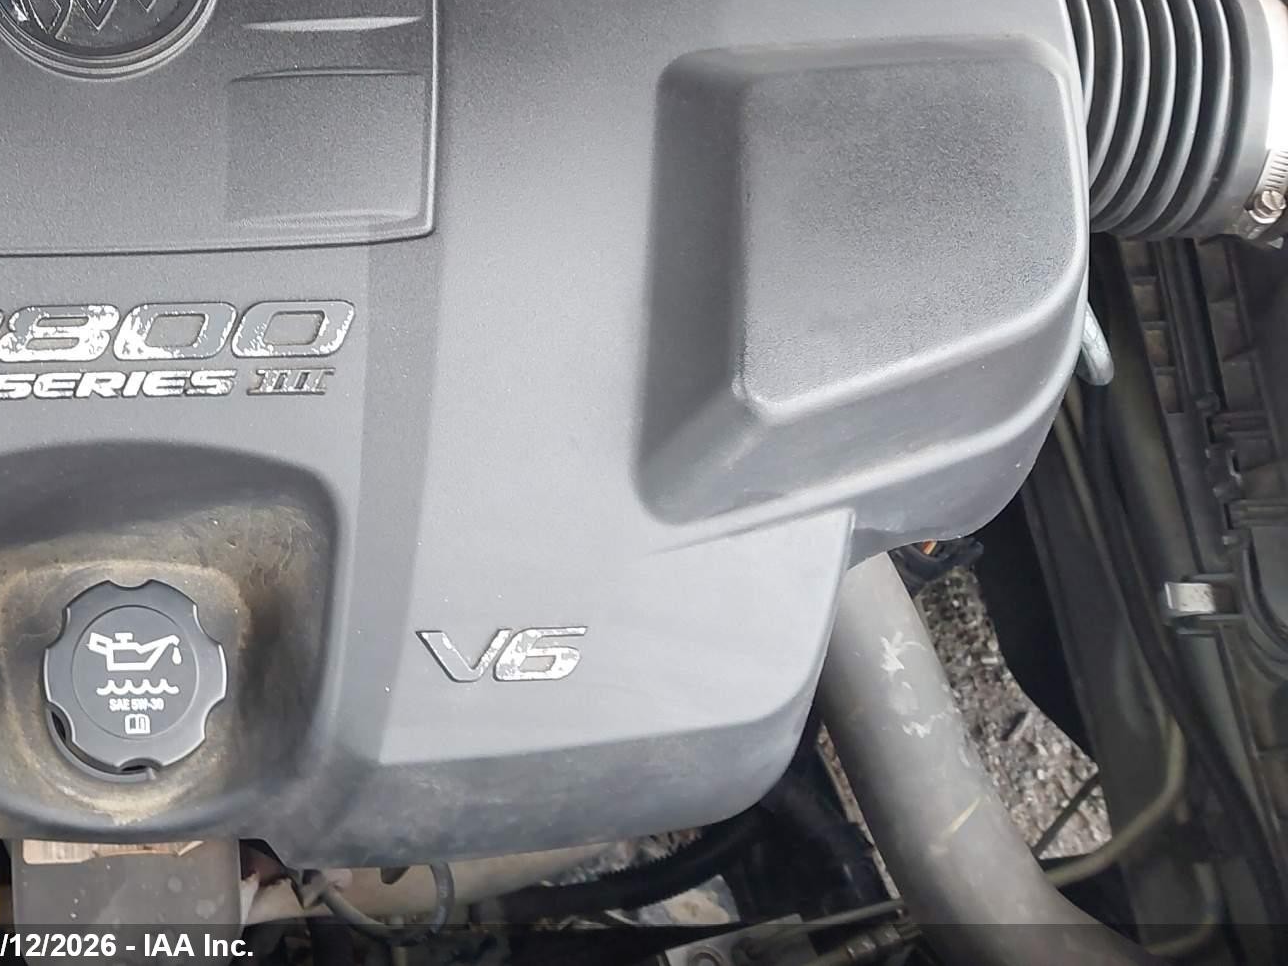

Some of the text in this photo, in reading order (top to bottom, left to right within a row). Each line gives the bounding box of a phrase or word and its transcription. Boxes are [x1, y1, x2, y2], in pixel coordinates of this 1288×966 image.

[246, 367, 336, 396] III
[414, 626, 589, 683] V6
[109, 697, 165, 712] SAE 5W-30
